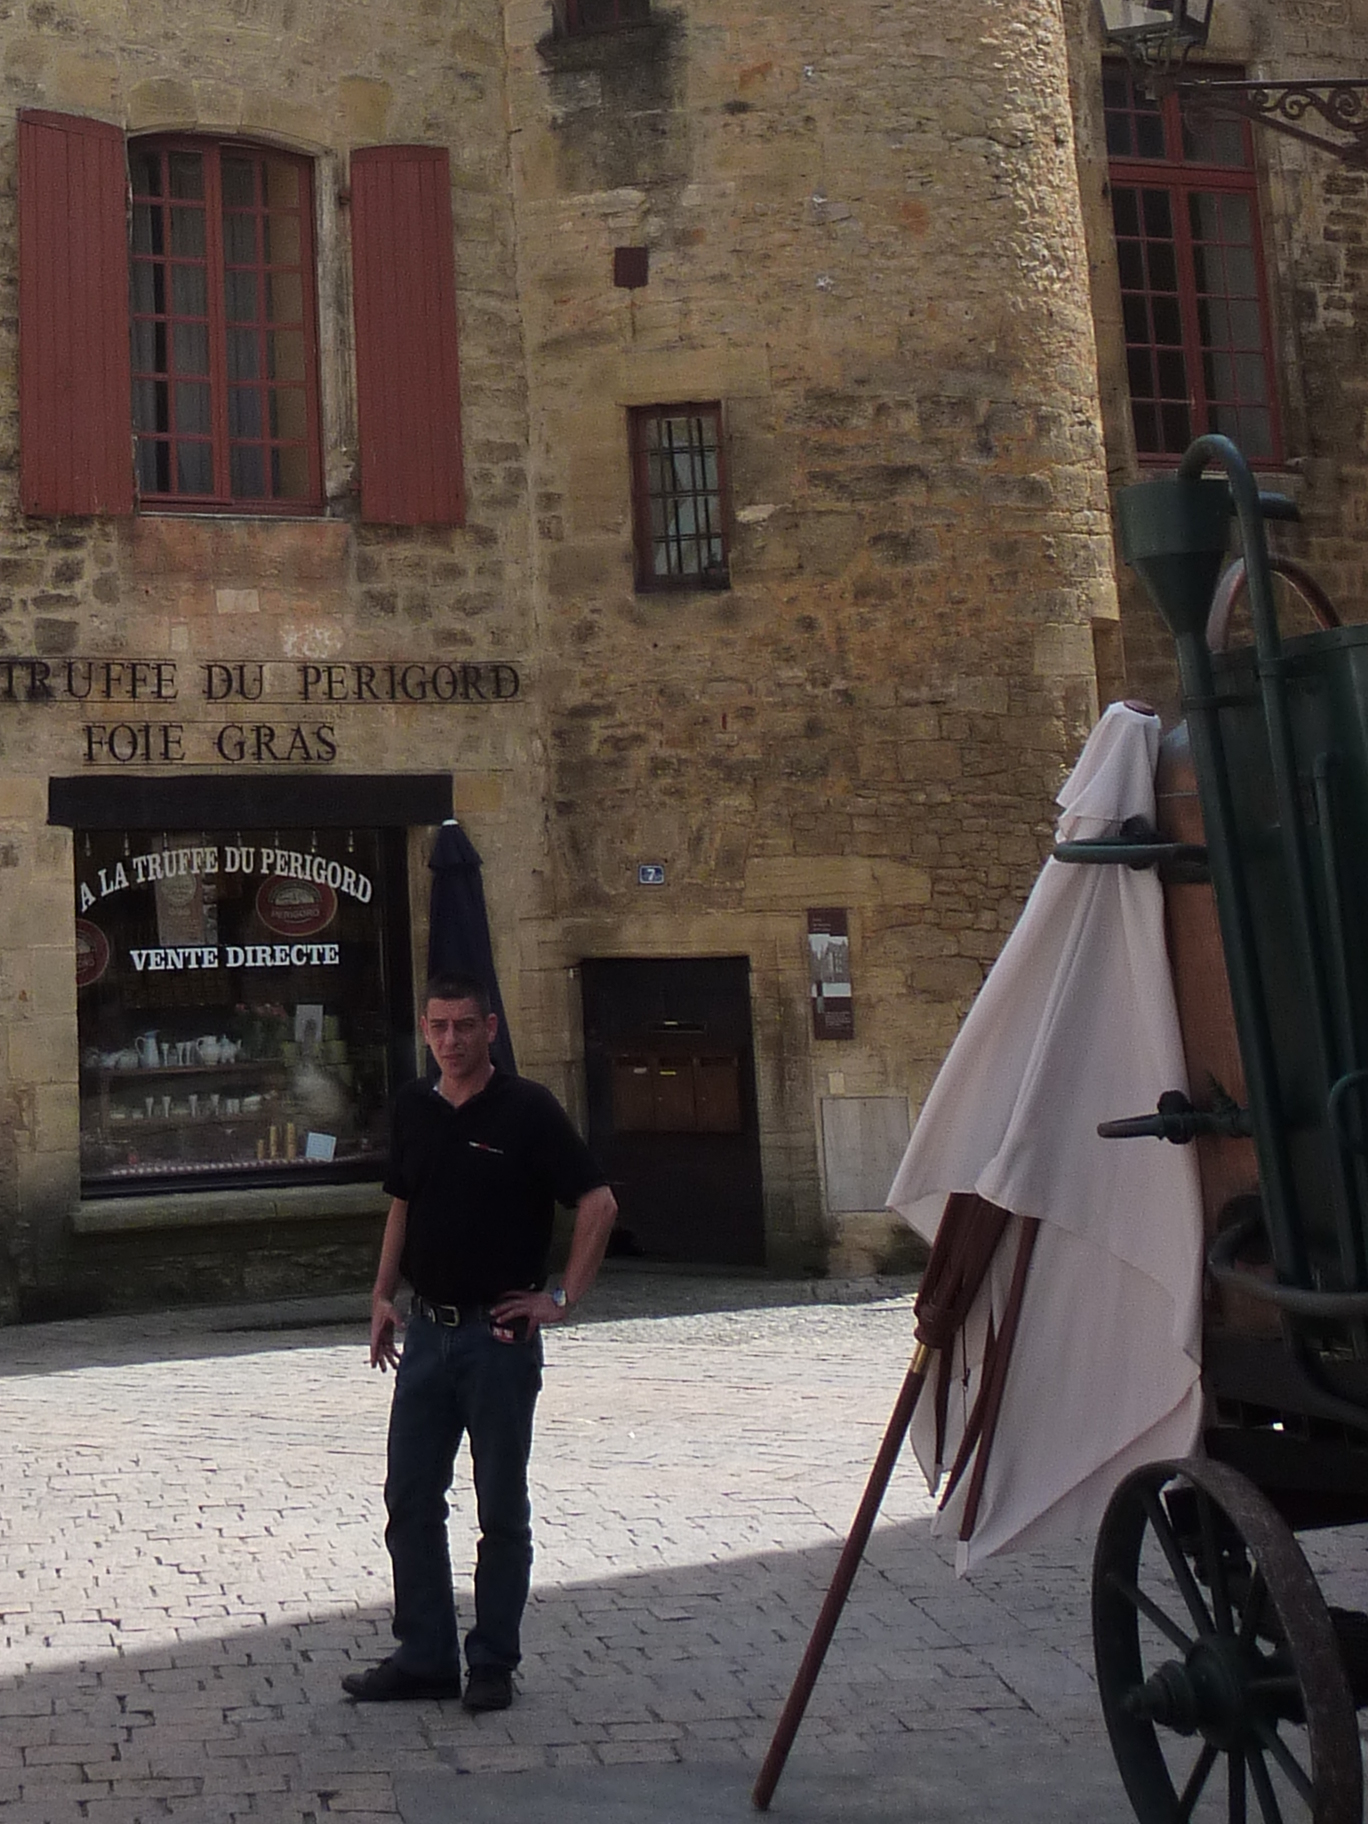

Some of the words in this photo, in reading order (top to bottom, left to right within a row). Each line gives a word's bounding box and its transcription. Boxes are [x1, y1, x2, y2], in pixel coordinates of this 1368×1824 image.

[205, 662, 266, 702] DU
[300, 662, 522, 702] PERIGORD
[83, 723, 185, 764] FOIE
[216, 723, 338, 764] GRAS
[81, 881, 96, 912] A
[98, 862, 129, 897] LA
[133, 847, 218, 884] TRUFFE
[224, 847, 255, 874] DU
[260, 847, 372, 903] PERIGORD
[647, 868, 656, 881] 7
[130, 946, 219, 971] VENTE
[226, 943, 340, 969] DIRECTE
